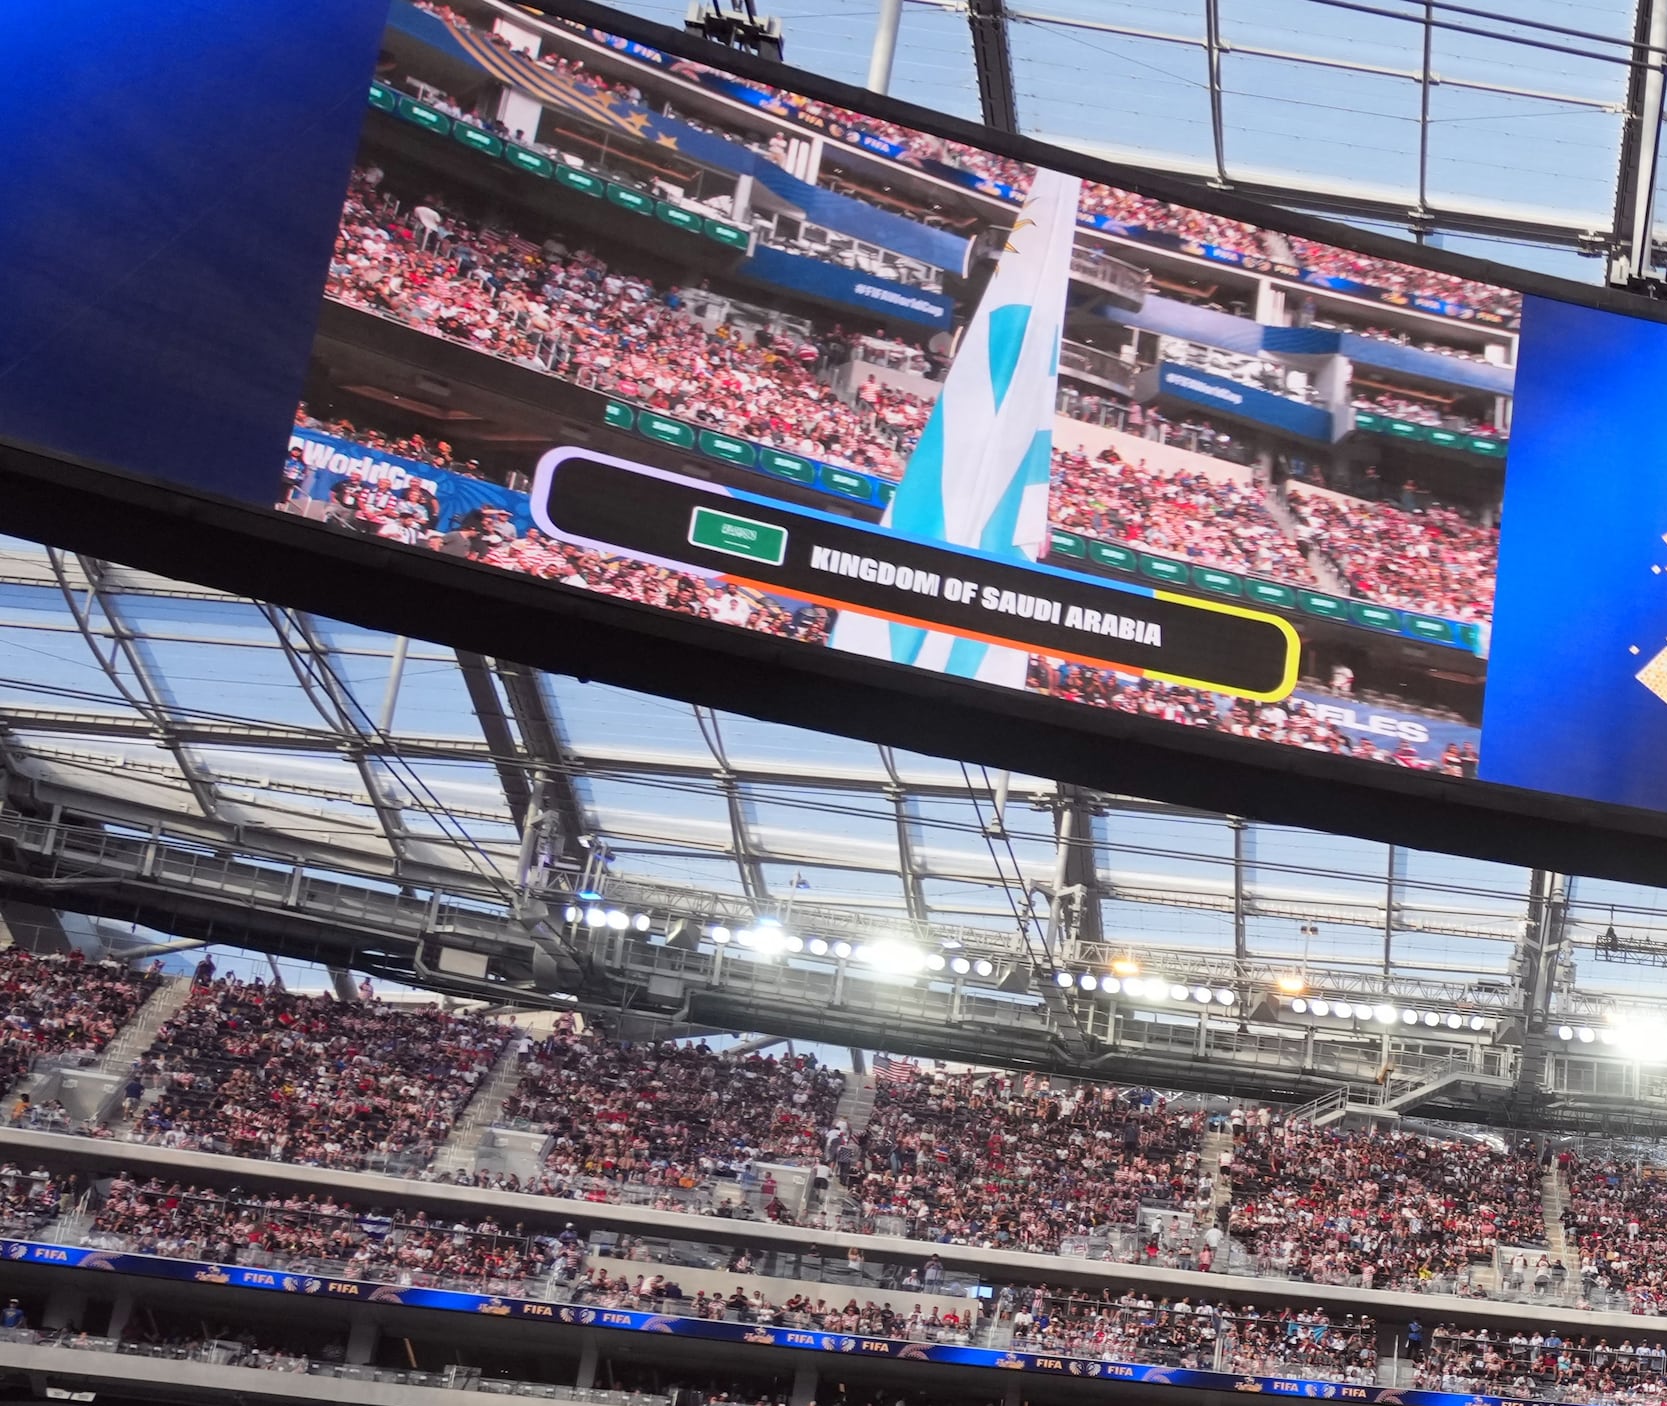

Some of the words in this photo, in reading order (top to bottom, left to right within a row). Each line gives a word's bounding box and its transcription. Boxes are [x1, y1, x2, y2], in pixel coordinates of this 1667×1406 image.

[811, 546, 940, 597] KINGDOM
[944, 578, 978, 604] OF
[981, 586, 1062, 624] SAUDI
[1064, 605, 1162, 647] ARABIA
[35, 1248, 67, 1260] FIFA
[244, 1273, 274, 1285] FIFA
[329, 1283, 358, 1294] FIFA
[524, 1304, 552, 1316] FIFA
[603, 1313, 631, 1324] FIFA
[787, 1333, 814, 1344] FIFA
[862, 1341, 889, 1352] FIFA
[1037, 1359, 1062, 1369] FIFA
[1108, 1366, 1133, 1376] FIFA
[1274, 1382, 1298, 1392] FIFA
[1342, 1388, 1366, 1397] FIFA
